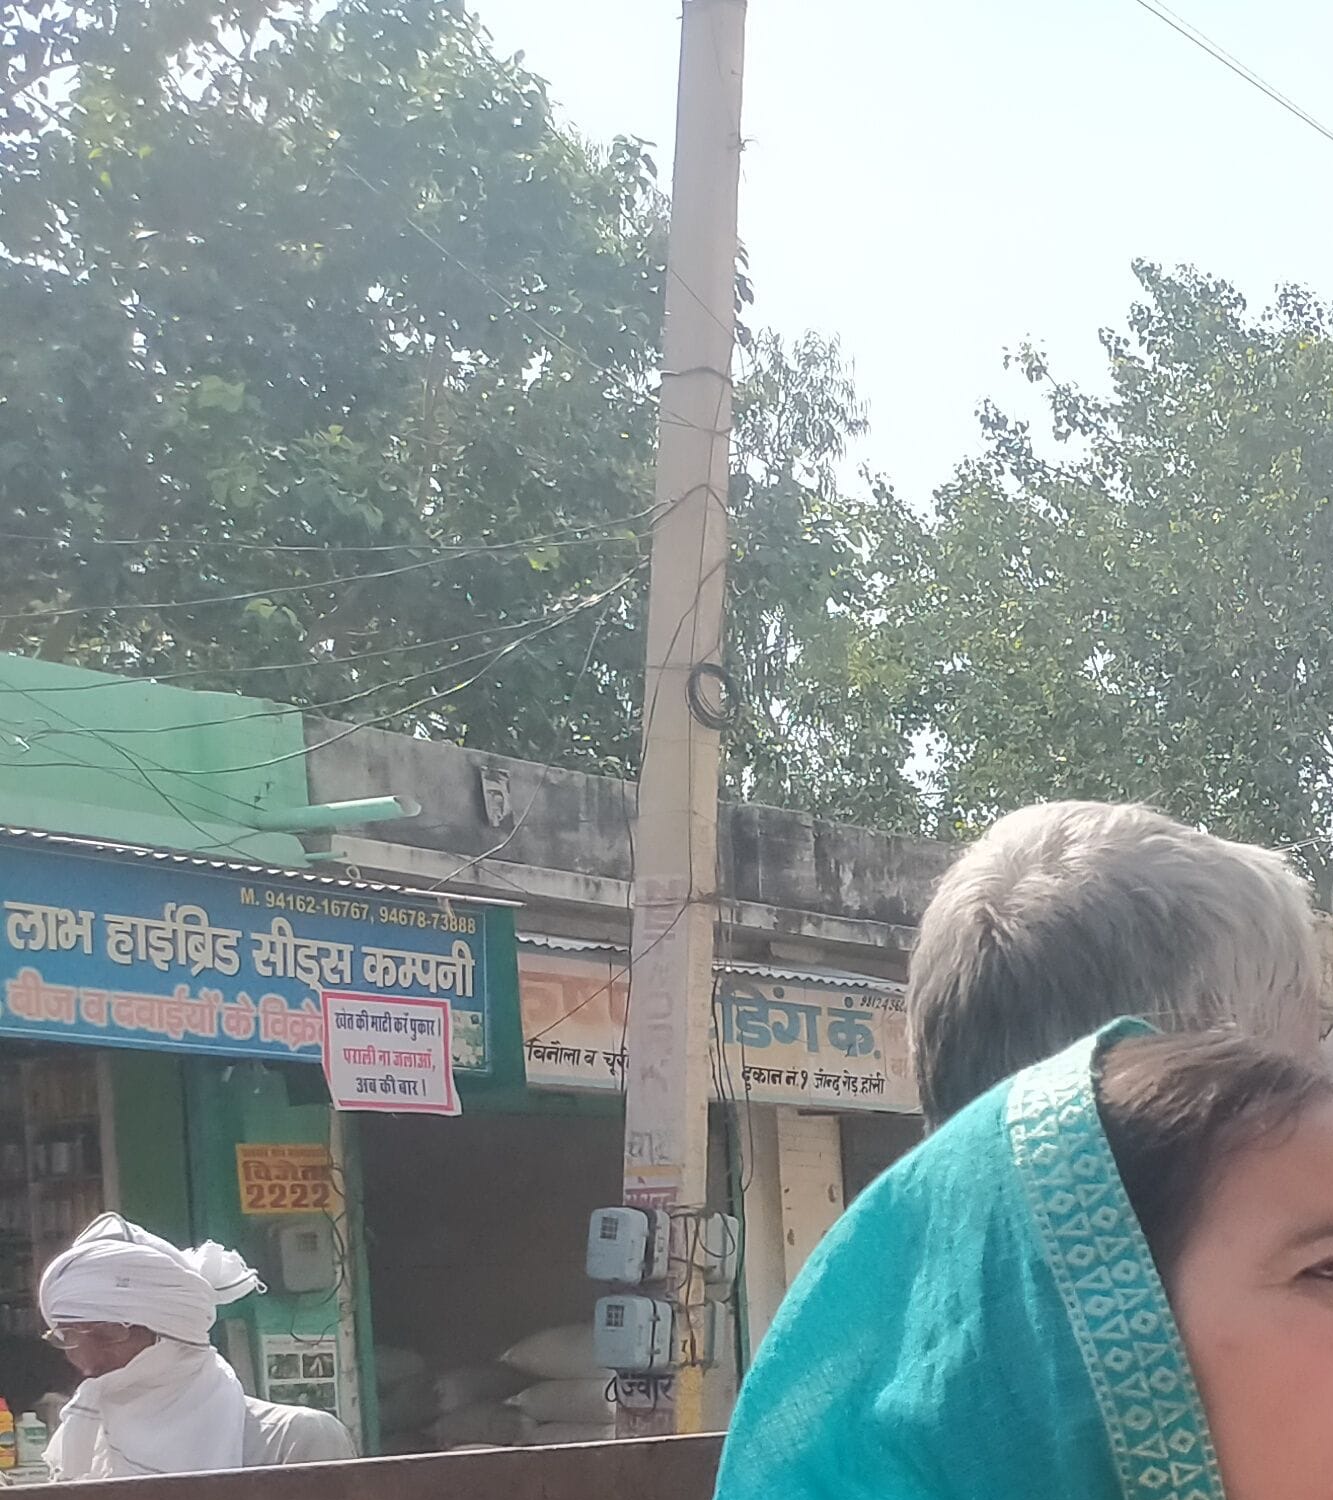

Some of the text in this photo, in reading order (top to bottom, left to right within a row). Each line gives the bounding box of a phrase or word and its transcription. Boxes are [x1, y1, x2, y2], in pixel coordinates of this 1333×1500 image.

[240, 886, 476, 934] M. 94162-16767, 94678-73888
[4, 900, 95, 954] लाभ
[104, 902, 243, 977] हाईब्रिड
[251, 917, 354, 993] सीड्स
[361, 940, 476, 997] कम्पनी
[8, 967, 77, 1024] बीज
[80, 985, 107, 1027] व
[221, 992, 255, 1040] के
[258, 993, 323, 1050] विक्रे
[355, 1009, 369, 1031] की
[371, 1011, 392, 1033] माटी
[343, 1045, 375, 1064] पराली
[378, 1050, 390, 1067] ना
[583, 1050, 598, 1066] व
[356, 1077, 376, 1094] अब
[379, 1074, 396, 1095] की
[246, 1183, 330, 1208] 2222
